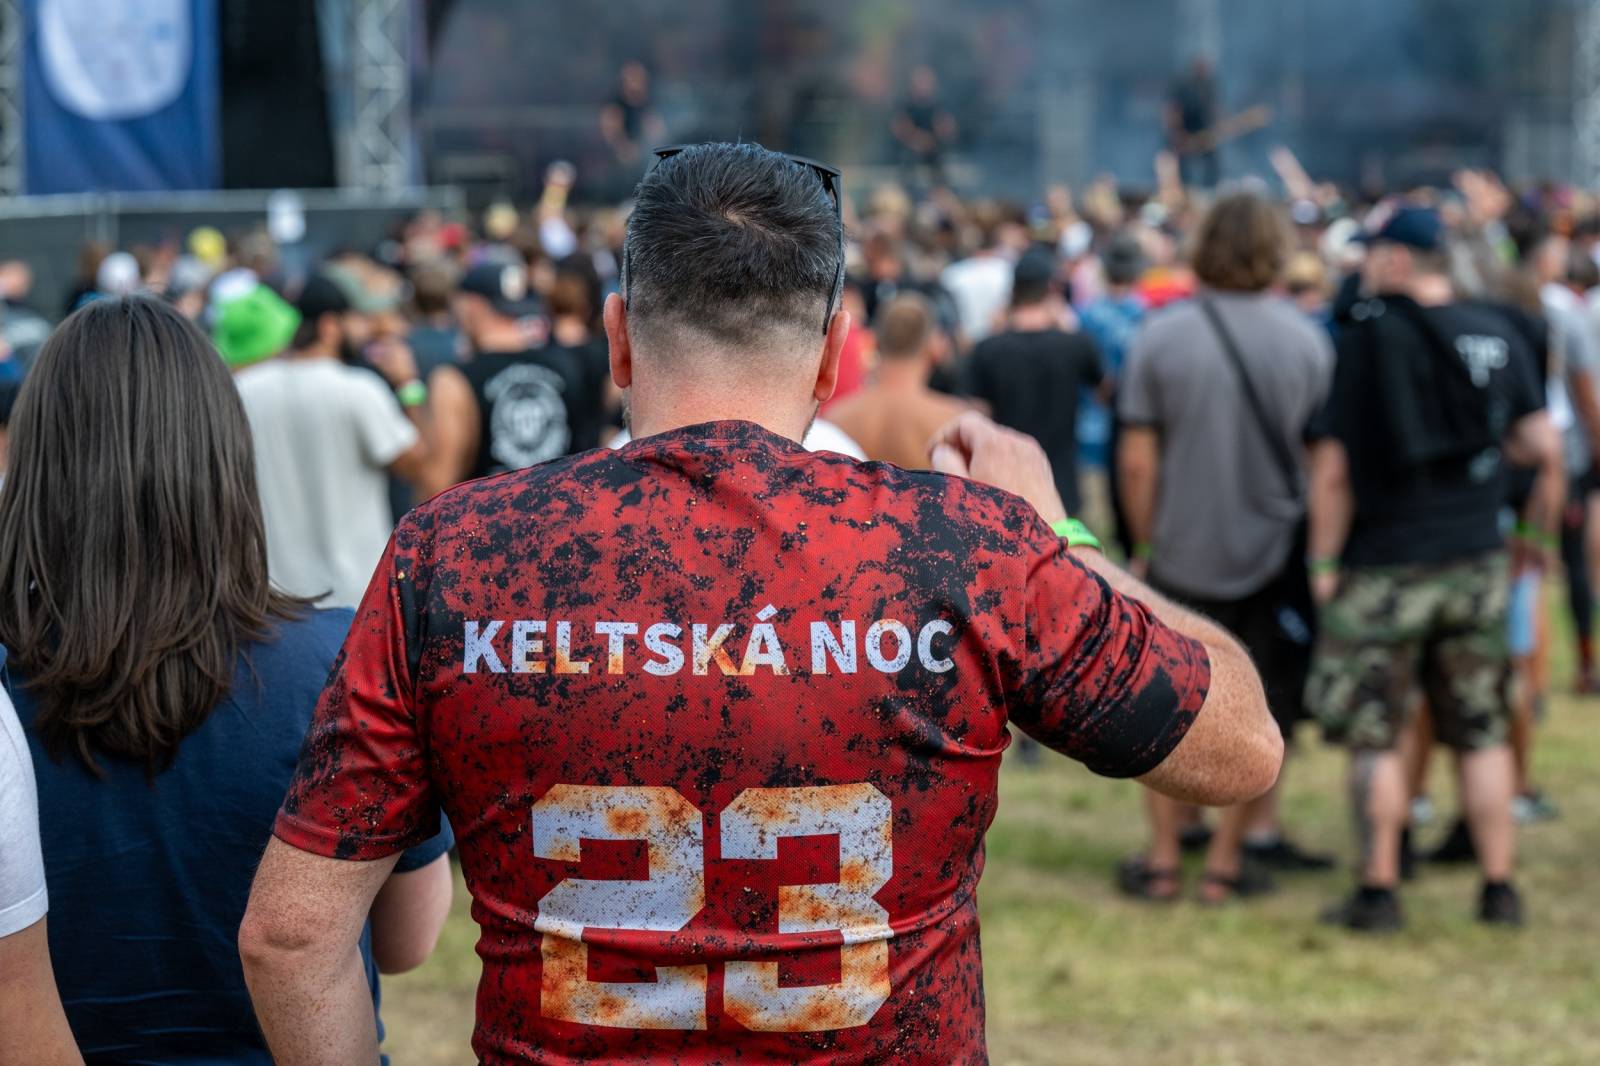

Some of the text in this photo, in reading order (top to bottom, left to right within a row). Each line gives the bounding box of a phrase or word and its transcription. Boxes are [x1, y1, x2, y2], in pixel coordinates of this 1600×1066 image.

[463, 604, 955, 676] KELTSKÁ NOC
[532, 783, 894, 1031] 23
